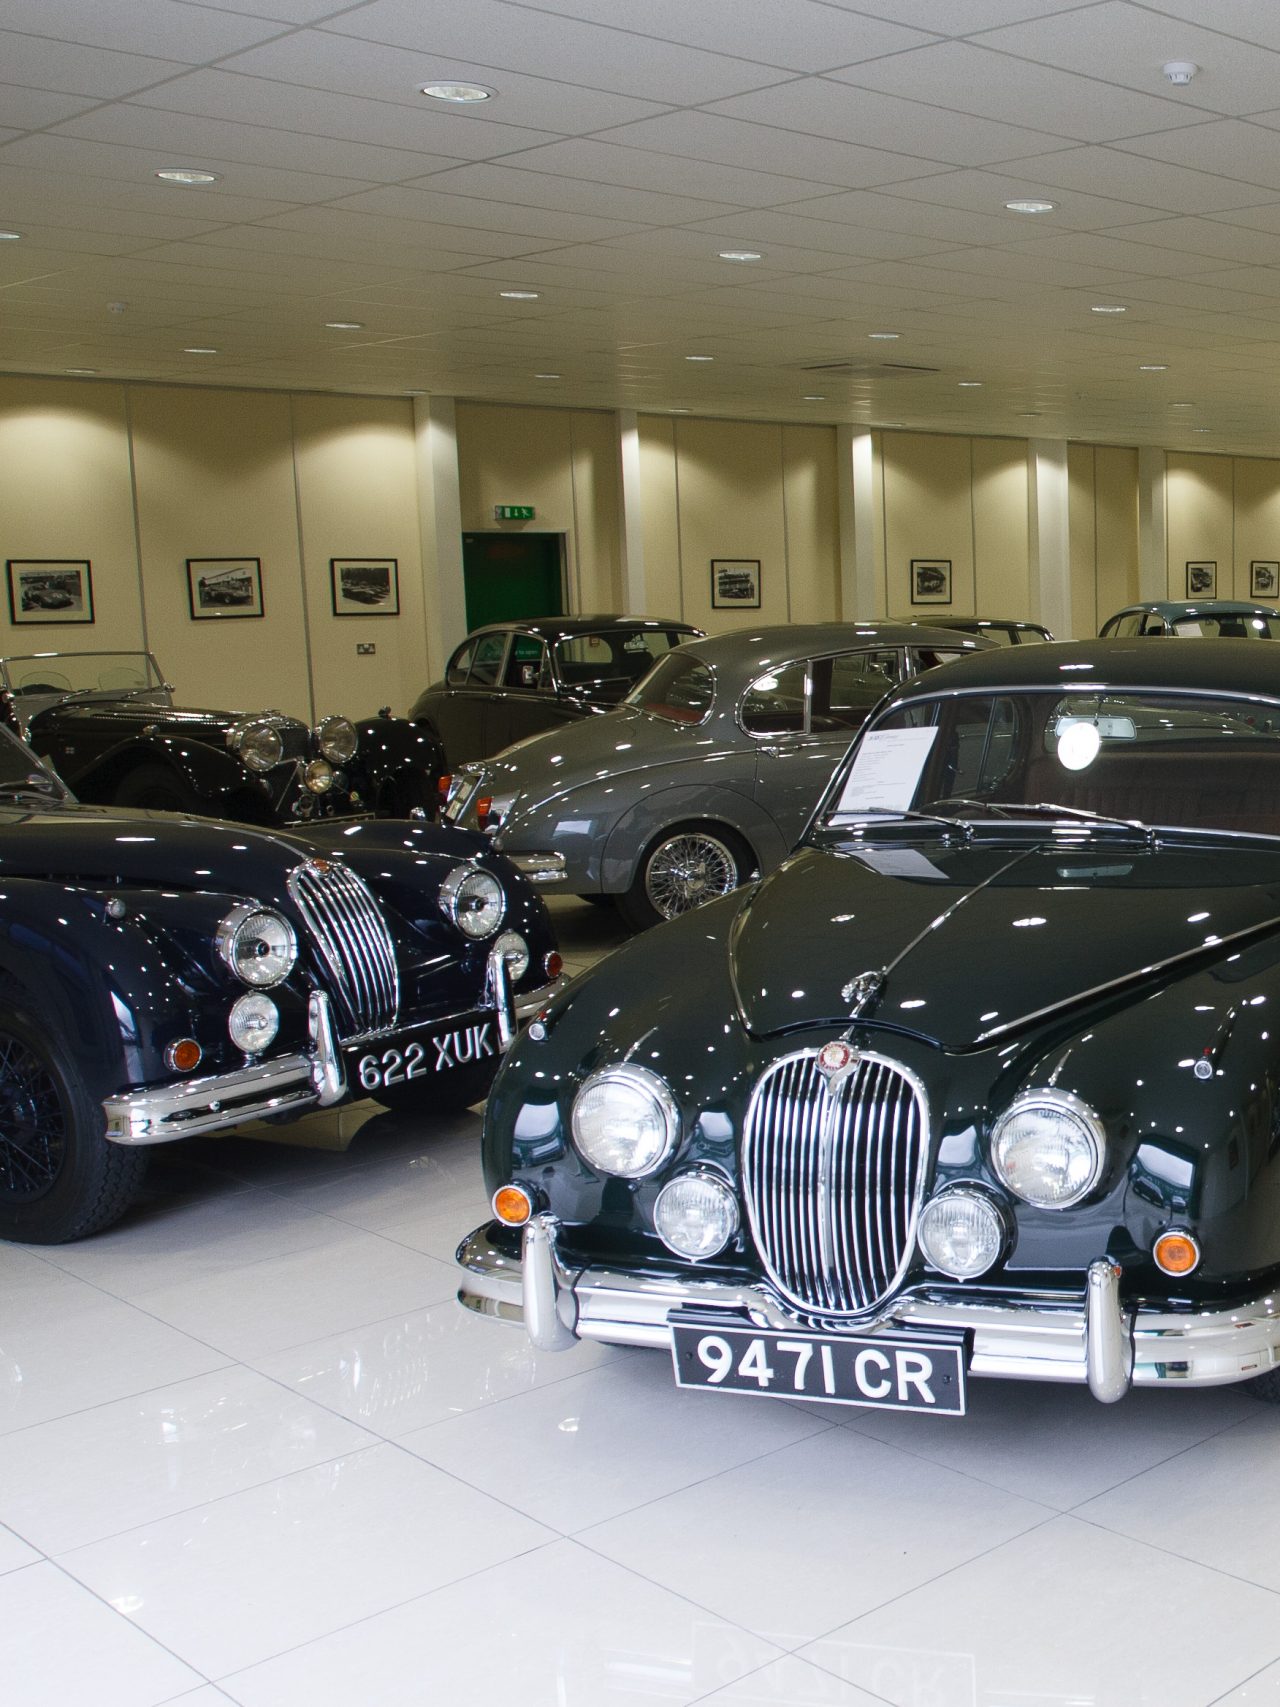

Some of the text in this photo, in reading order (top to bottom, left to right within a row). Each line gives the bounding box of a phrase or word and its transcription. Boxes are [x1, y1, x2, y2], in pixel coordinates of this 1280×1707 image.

[359, 1022, 494, 1091] 622 XUK
[696, 1334, 936, 1404] 9471 CR
